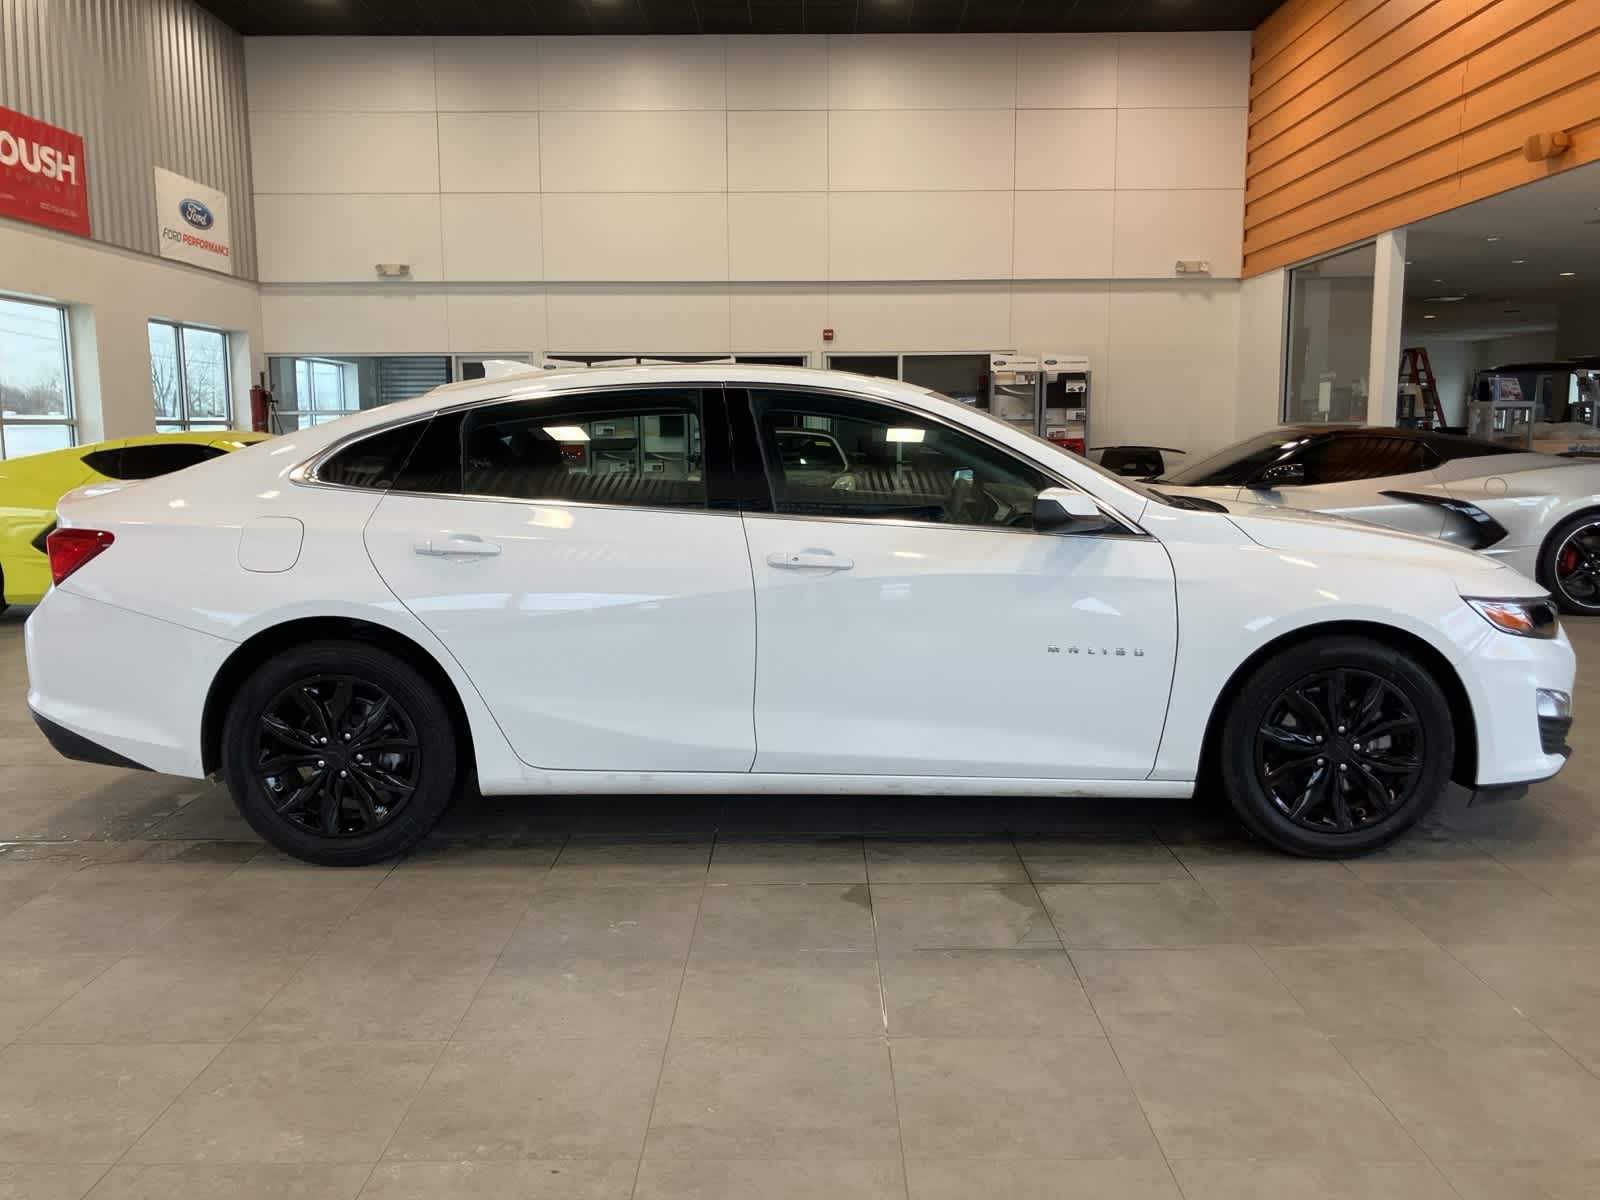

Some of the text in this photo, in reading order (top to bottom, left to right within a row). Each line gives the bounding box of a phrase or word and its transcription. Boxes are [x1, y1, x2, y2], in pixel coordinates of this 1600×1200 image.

[186, 202, 208, 226] Ford
[163, 227, 182, 242] FORD
[1047, 646, 1144, 657] MALIBU
